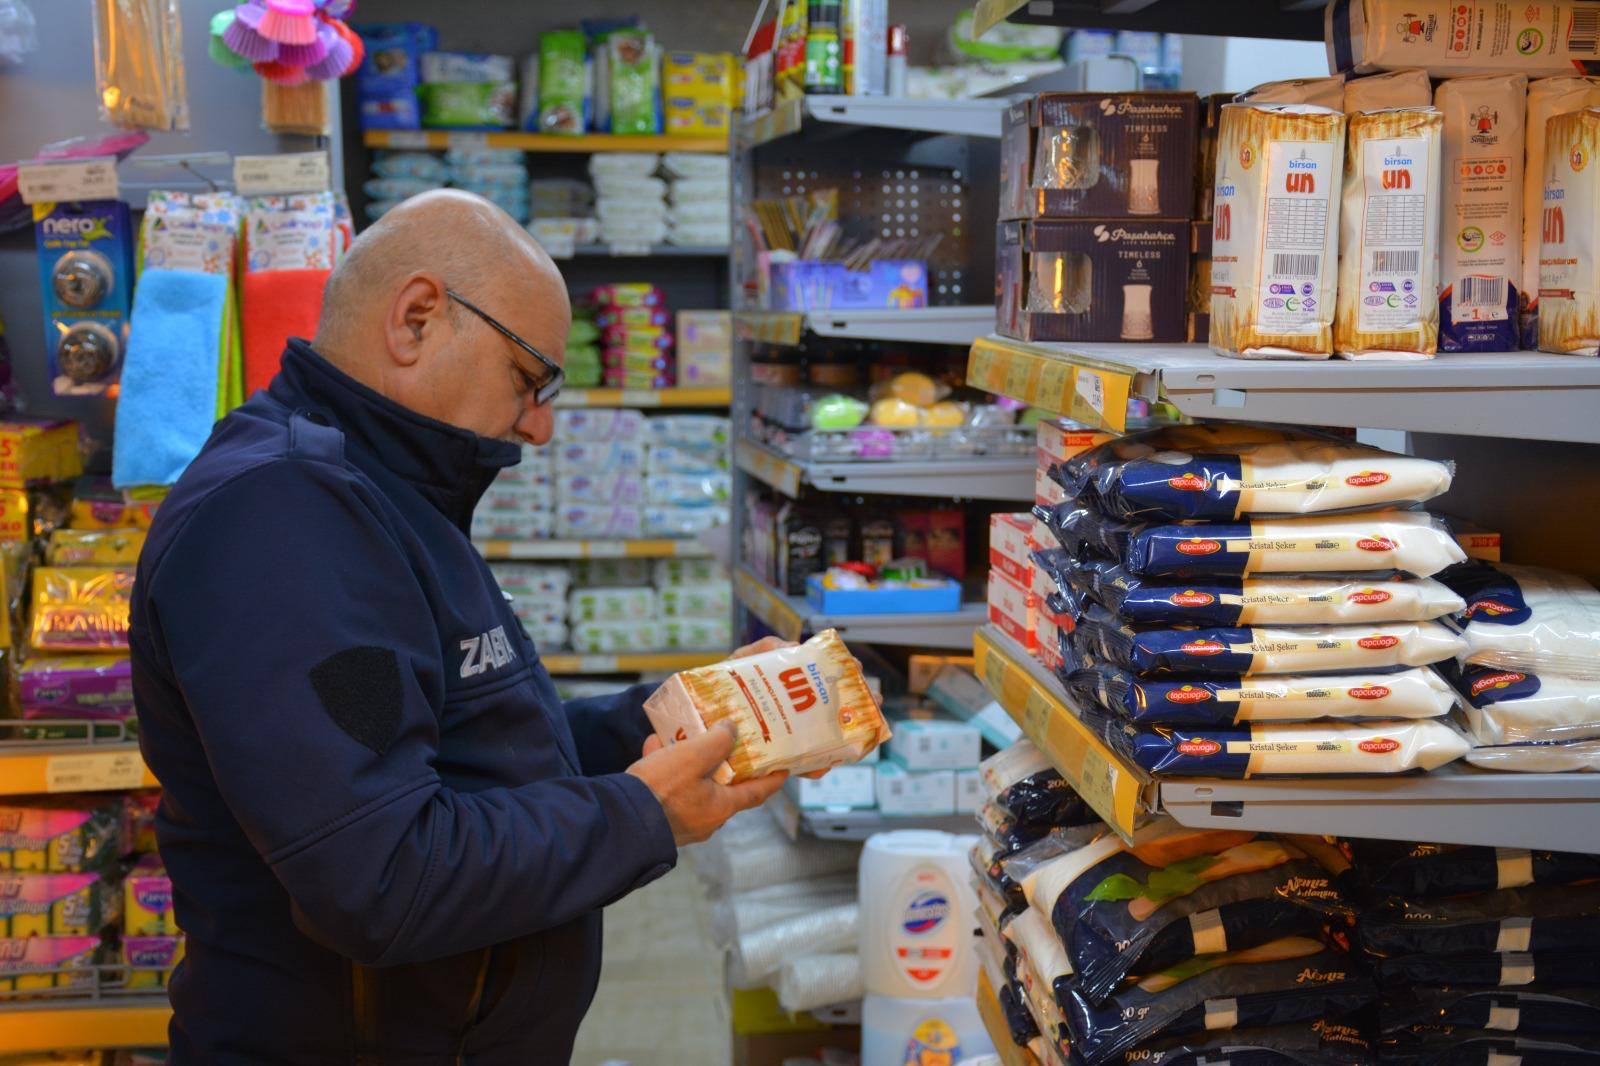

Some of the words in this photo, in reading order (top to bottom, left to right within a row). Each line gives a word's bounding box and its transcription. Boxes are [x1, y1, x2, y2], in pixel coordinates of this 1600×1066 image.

[1124, 124, 1168, 133] TIMELESS
[1289, 160, 1317, 169] birsan
[1384, 158, 1412, 166] birsan
[1118, 250, 1161, 259] TIMELESS
[1248, 541, 1273, 550] Kristal
[1275, 541, 1297, 551] Şeker
[1241, 596, 1267, 605] Kristal
[1276, 644, 1299, 653] Şeker
[806, 662, 830, 704] birsan
[1238, 691, 1264, 700] Kristal
[1249, 743, 1274, 752] Kristal
[1276, 743, 1298, 753] Şeker
